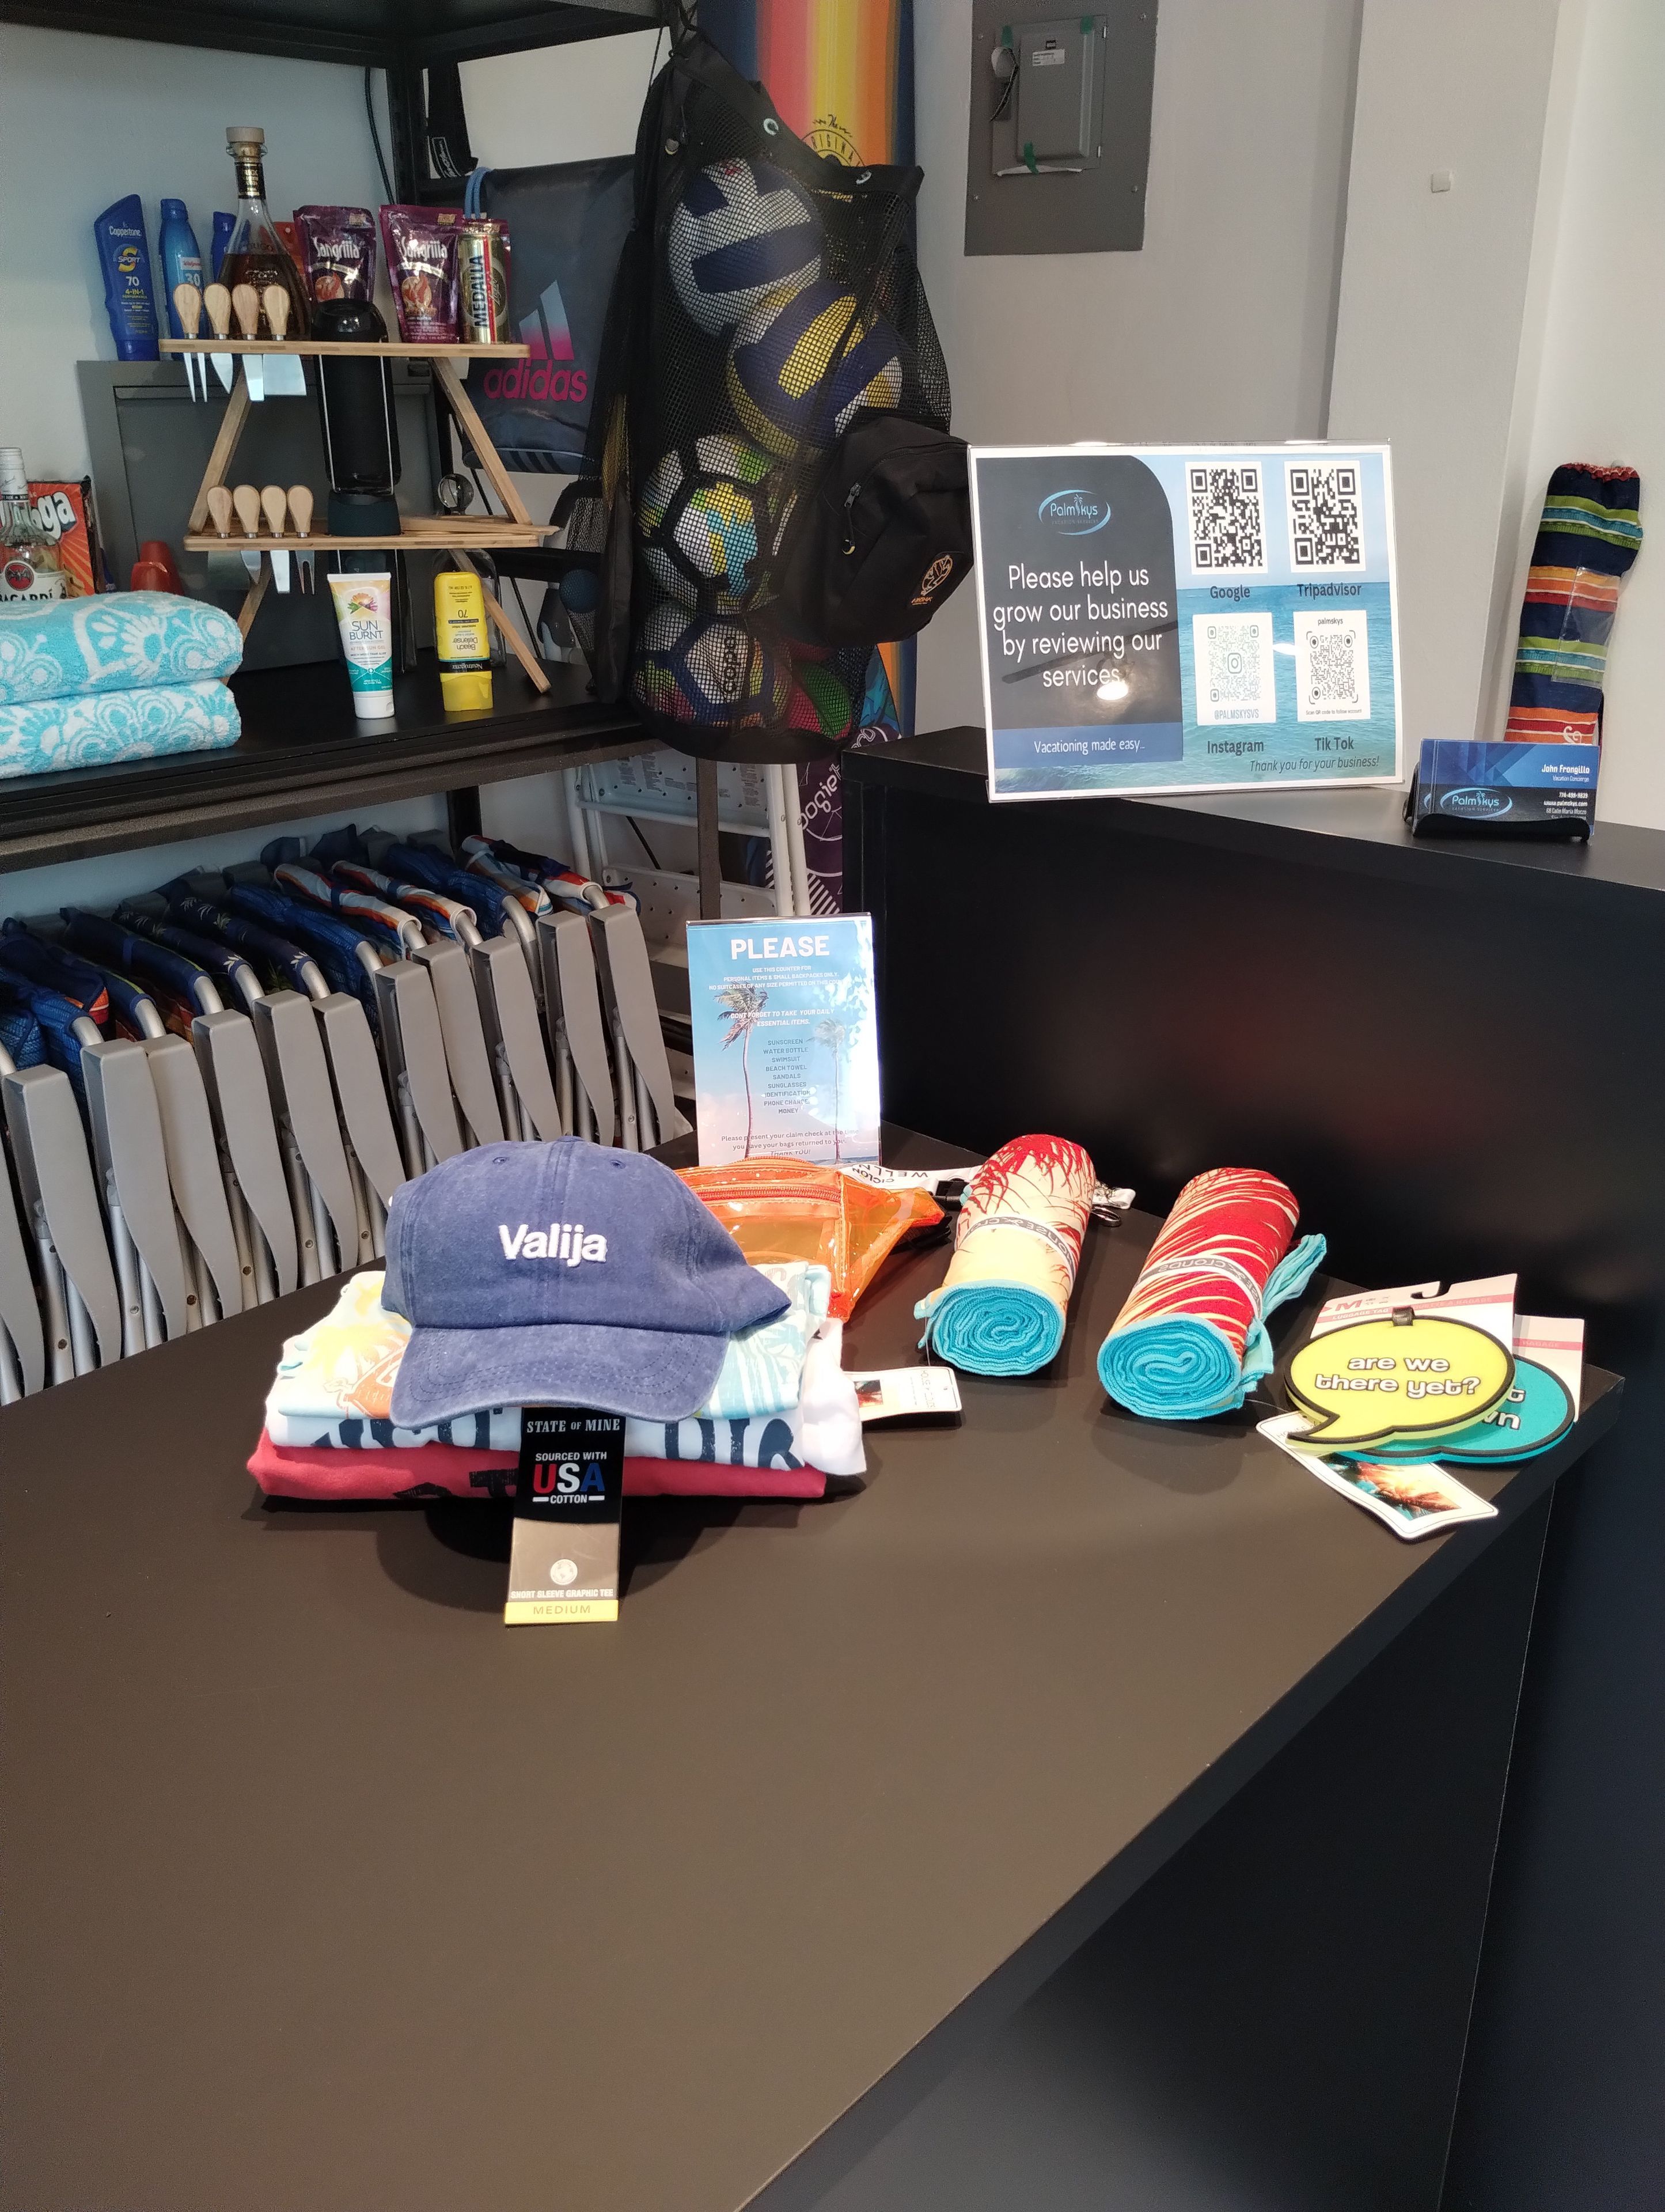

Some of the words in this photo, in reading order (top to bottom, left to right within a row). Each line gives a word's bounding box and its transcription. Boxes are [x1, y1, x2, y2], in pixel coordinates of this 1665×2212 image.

[109, 226, 142, 237] Coppertone
[126, 276, 139, 286] 70
[469, 255, 488, 327] MEDALLA
[484, 358, 587, 403] adidas
[1008, 563, 1074, 590] Please
[1080, 560, 1122, 594] help
[1129, 567, 1150, 586] us
[1209, 585, 1250, 602] Google
[1296, 582, 1362, 600] Tripadvisor
[458, 609, 468, 618] 70
[993, 606, 1042, 631] grow
[1049, 603, 1081, 621] our
[1087, 594, 1169, 620] business
[352, 620, 378, 631] SUN
[1317, 617, 1343, 626] palmskys
[349, 630, 384, 640] BURNT
[1002, 630, 1026, 663] by
[1032, 631, 1125, 659] reviewing
[1132, 633, 1162, 651] our
[1214, 709, 1259, 720] @PALMSKYSVS
[1034, 738, 1088, 755] Vacationing
[1091, 737, 1117, 751] made
[1207, 740, 1264, 756] Instagram
[1315, 737, 1331, 751] Tik
[1333, 736, 1355, 750] Tok
[1250, 760, 1277, 772] Thank
[1279, 761, 1296, 774] you
[1299, 758, 1313, 770] for
[1313, 759, 1336, 772] your
[1337, 756, 1380, 769] business!
[1542, 764, 1558, 773] John
[1559, 764, 1590, 775] Frongillo
[731, 935, 830, 960] PLEASE
[765, 1090, 811, 1098] IDENTIFICATION
[498, 1223, 608, 1267] Valija
[1332, 1310, 1371, 1320] LUGGAGE
[1347, 1357, 1397, 1371] are
[1403, 1357, 1450, 1373] we
[1314, 1373, 1399, 1392] there
[1406, 1376, 1481, 1399] yet?
[526, 1419, 566, 1433] STATE
[571, 1421, 582, 1430] OF
[585, 1418, 620, 1431] MINE
[1276, 1425, 1307, 1439] HOSE
[535, 1452, 581, 1461] SOURCED
[583, 1451, 607, 1460] WITH
[533, 1462, 605, 1494] USA
[550, 1494, 587, 1504] COTTON
[510, 1590, 536, 1599] SHORT
[537, 1589, 564, 1599] SLEEVE
[566, 1589, 598, 1598] GRAPHIC
[600, 1588, 614, 1597] TEE
[533, 1605, 591, 1615] MEDIUM
